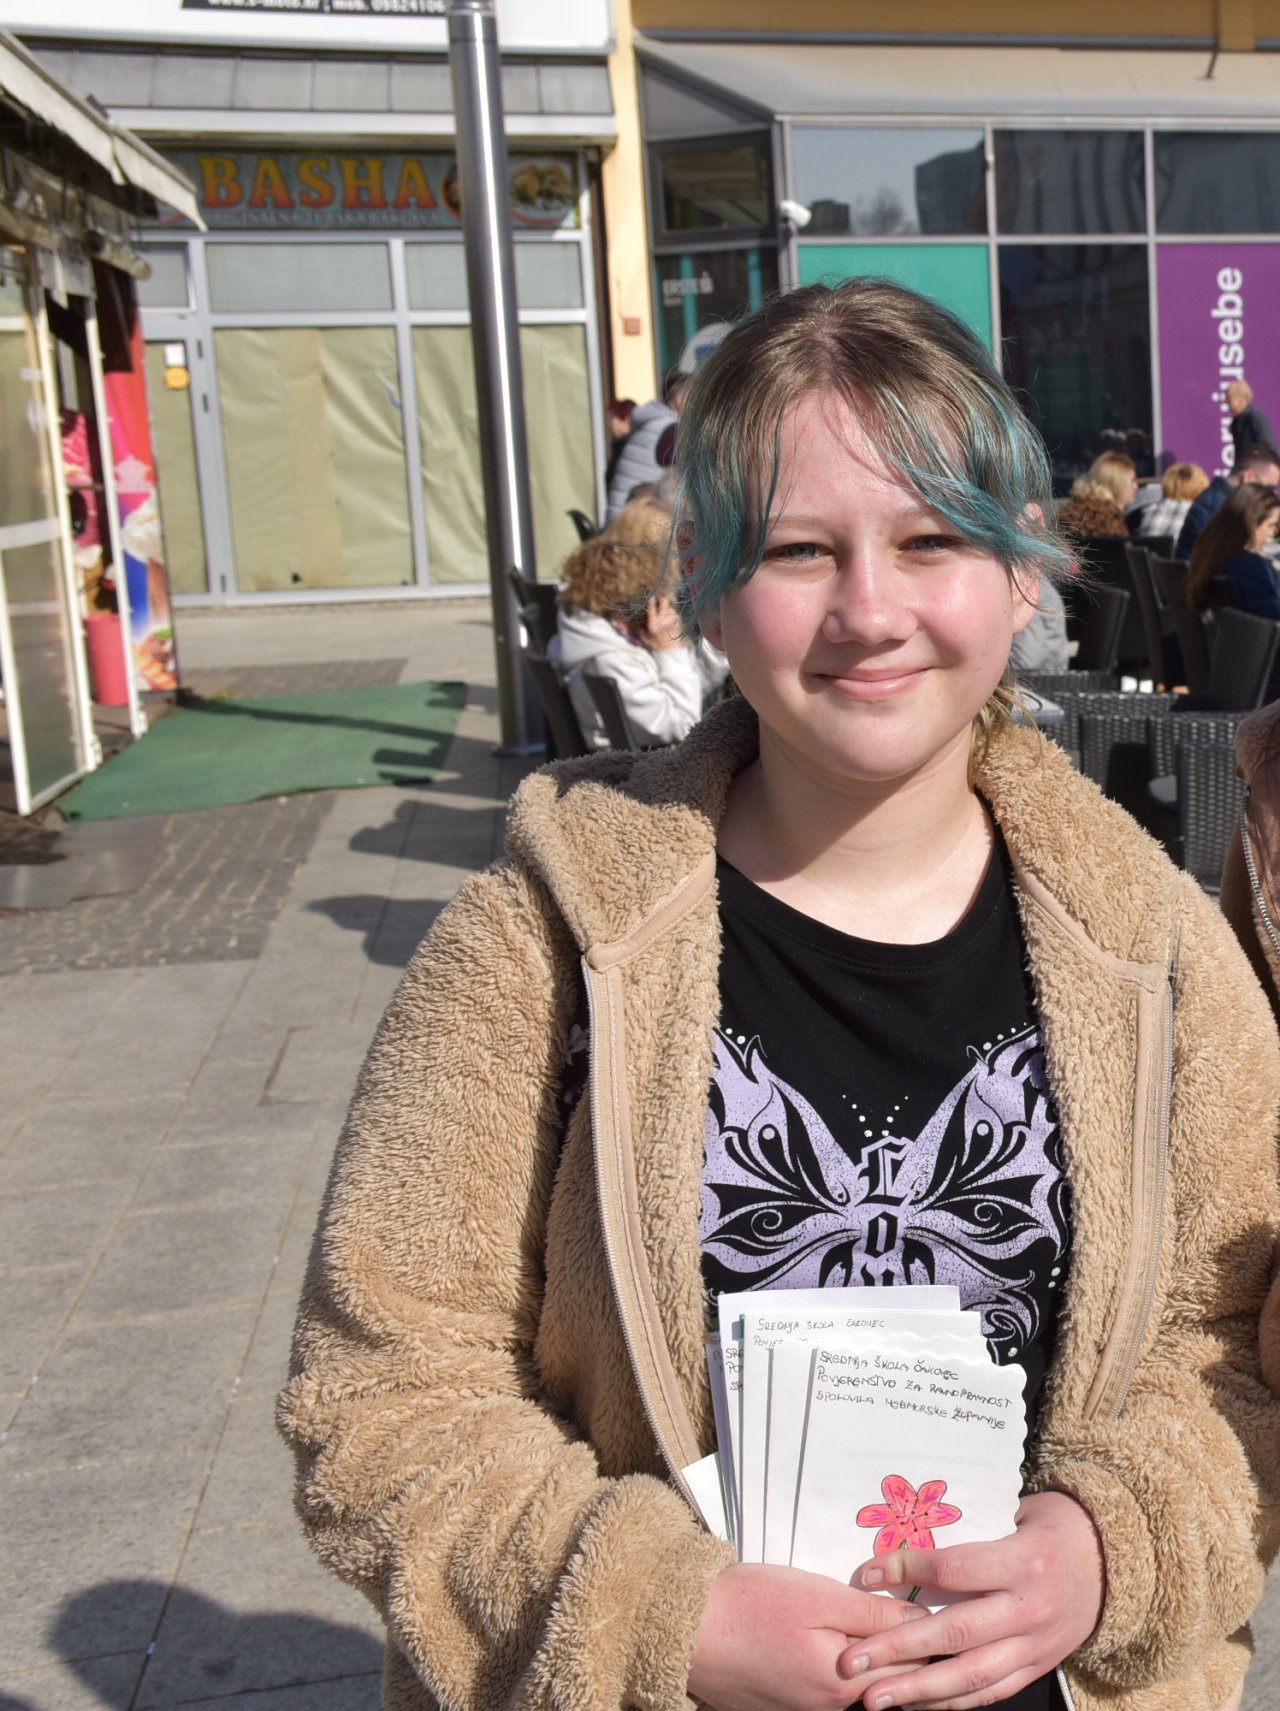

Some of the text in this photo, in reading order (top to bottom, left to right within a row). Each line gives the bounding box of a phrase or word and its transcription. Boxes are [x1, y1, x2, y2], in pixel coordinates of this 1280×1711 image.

[196, 157, 438, 208] BASHA
[874, 1355, 909, 1371] ŠKOLA
[914, 1359, 959, 1380] ČAKOVEC
